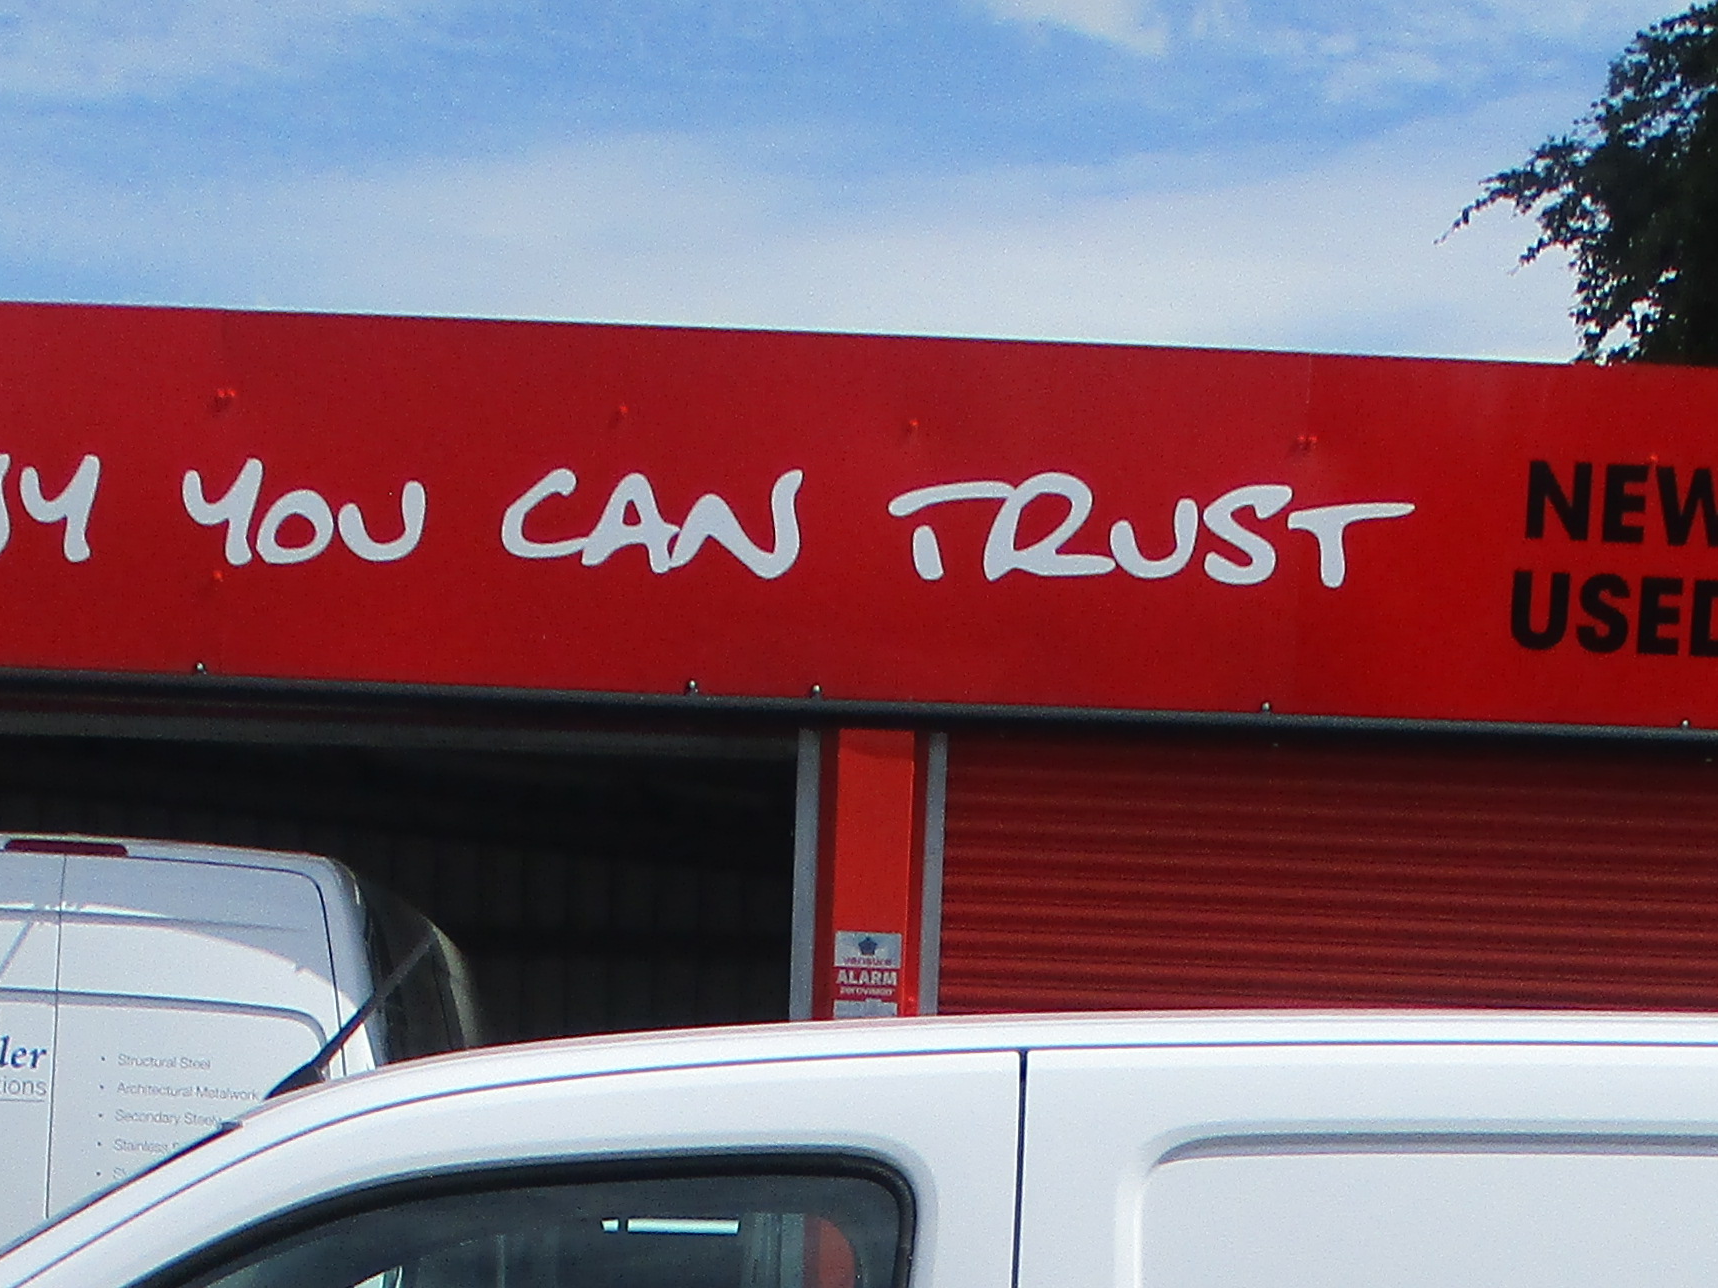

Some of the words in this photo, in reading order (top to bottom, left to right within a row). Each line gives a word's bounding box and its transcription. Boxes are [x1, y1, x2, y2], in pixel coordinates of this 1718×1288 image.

[183, 459, 426, 565] YOU
[502, 469, 804, 579] CAN
[888, 472, 1415, 587] TRUST
[836, 969, 897, 986] ALARM
[117, 1053, 177, 1068] Structural
[180, 1057, 211, 1070] Steel
[116, 1082, 192, 1098] Architectural
[196, 1086, 259, 1101] Metalwork
[114, 1109, 179, 1126] Secondary
